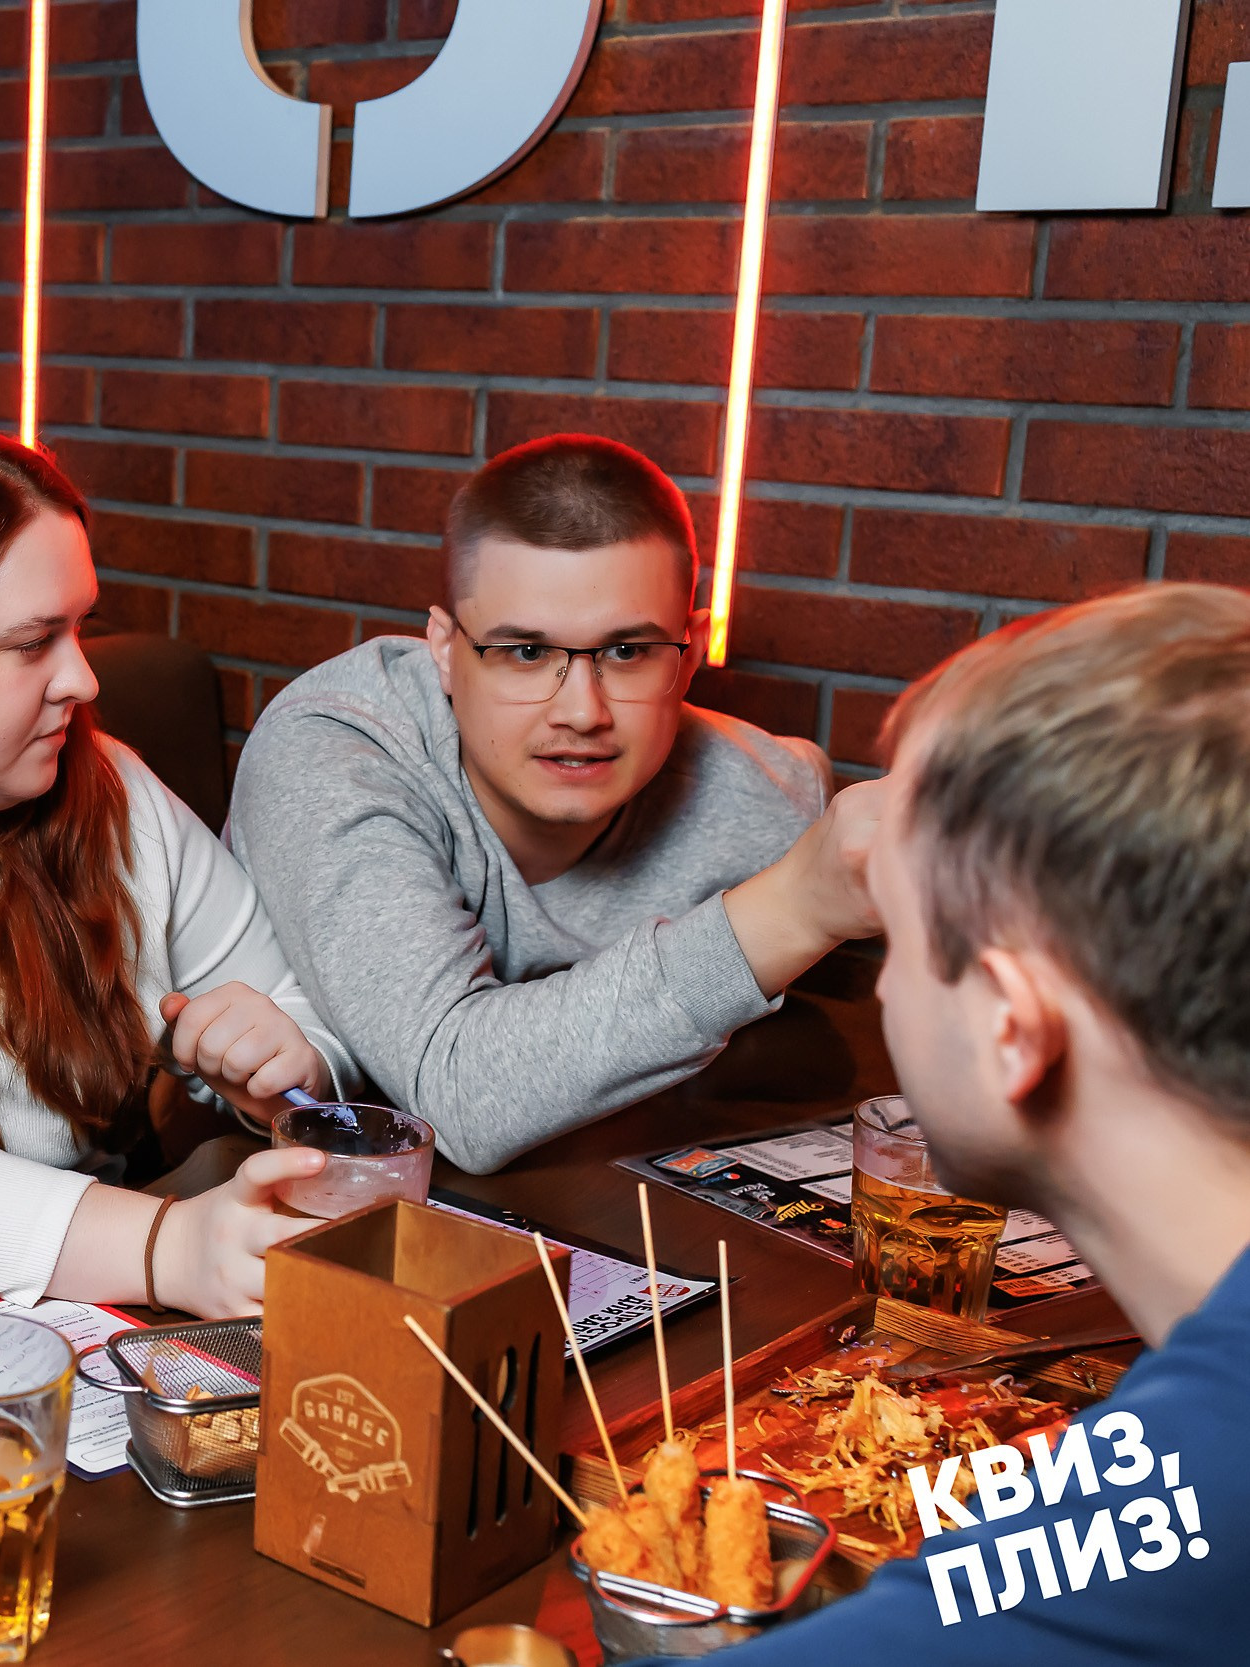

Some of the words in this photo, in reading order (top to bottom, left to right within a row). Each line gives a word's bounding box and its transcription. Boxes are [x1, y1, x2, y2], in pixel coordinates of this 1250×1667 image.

[778, 1200, 824, 1221] Miller
[601, 1294, 647, 1315] ДЛЯ
[303, 1400, 390, 1447] GARAGE
